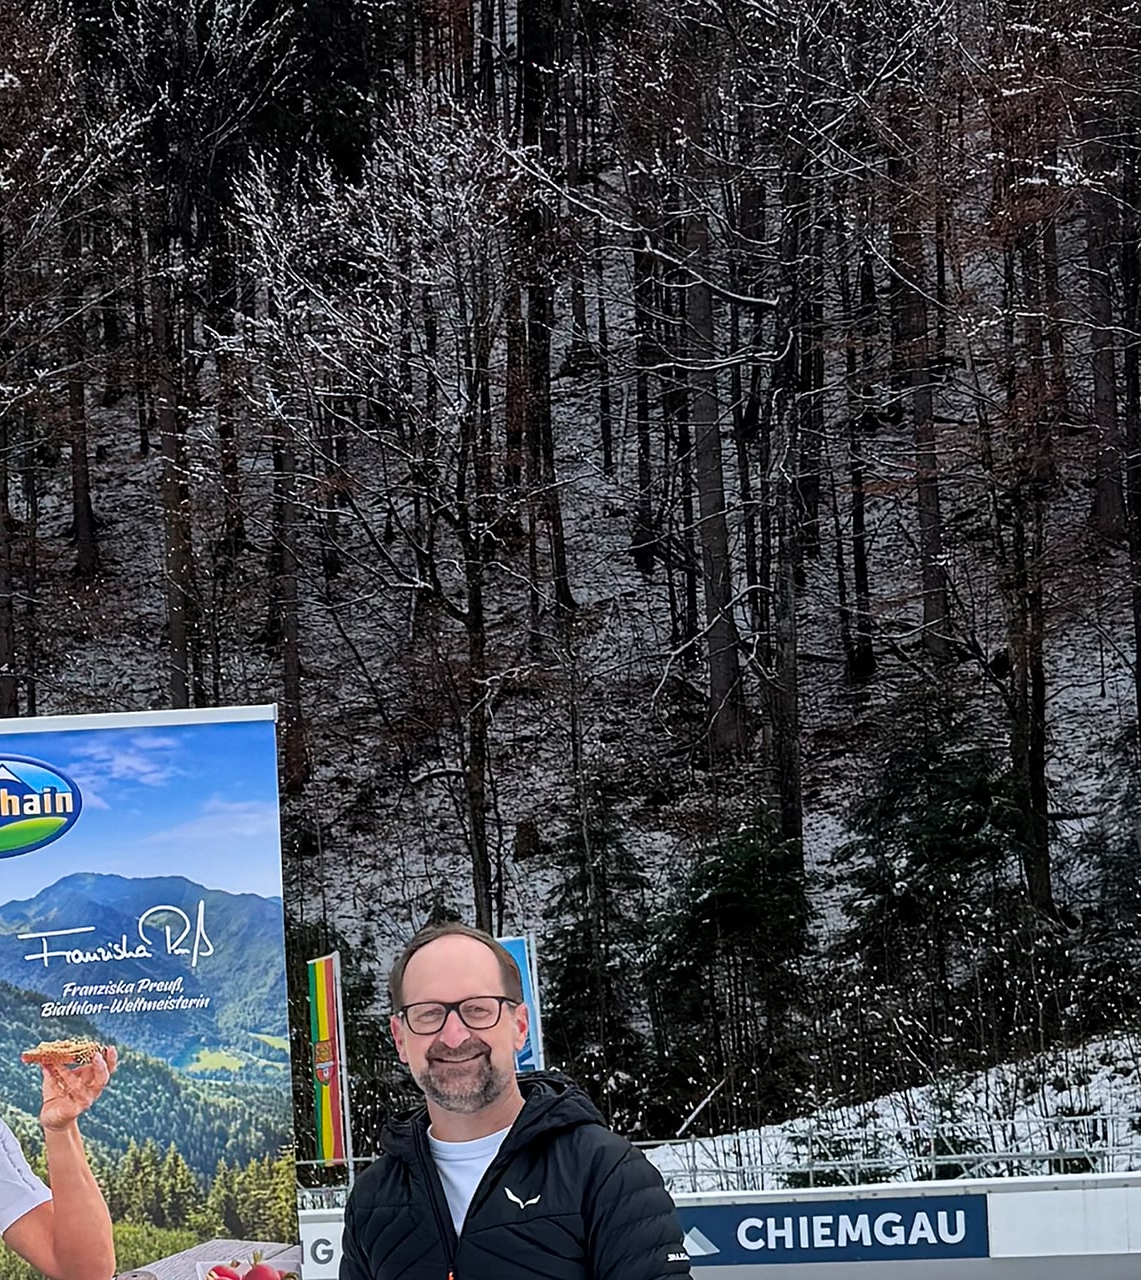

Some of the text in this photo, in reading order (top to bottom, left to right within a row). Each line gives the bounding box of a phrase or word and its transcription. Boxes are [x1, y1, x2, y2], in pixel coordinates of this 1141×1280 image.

[62, 976, 184, 998] Franziska Preuß,
[41, 994, 211, 1018] Biathlon-Weltmeisterin
[736, 1209, 967, 1251] CHIEMGAU
[310, 1238, 335, 1265] G
